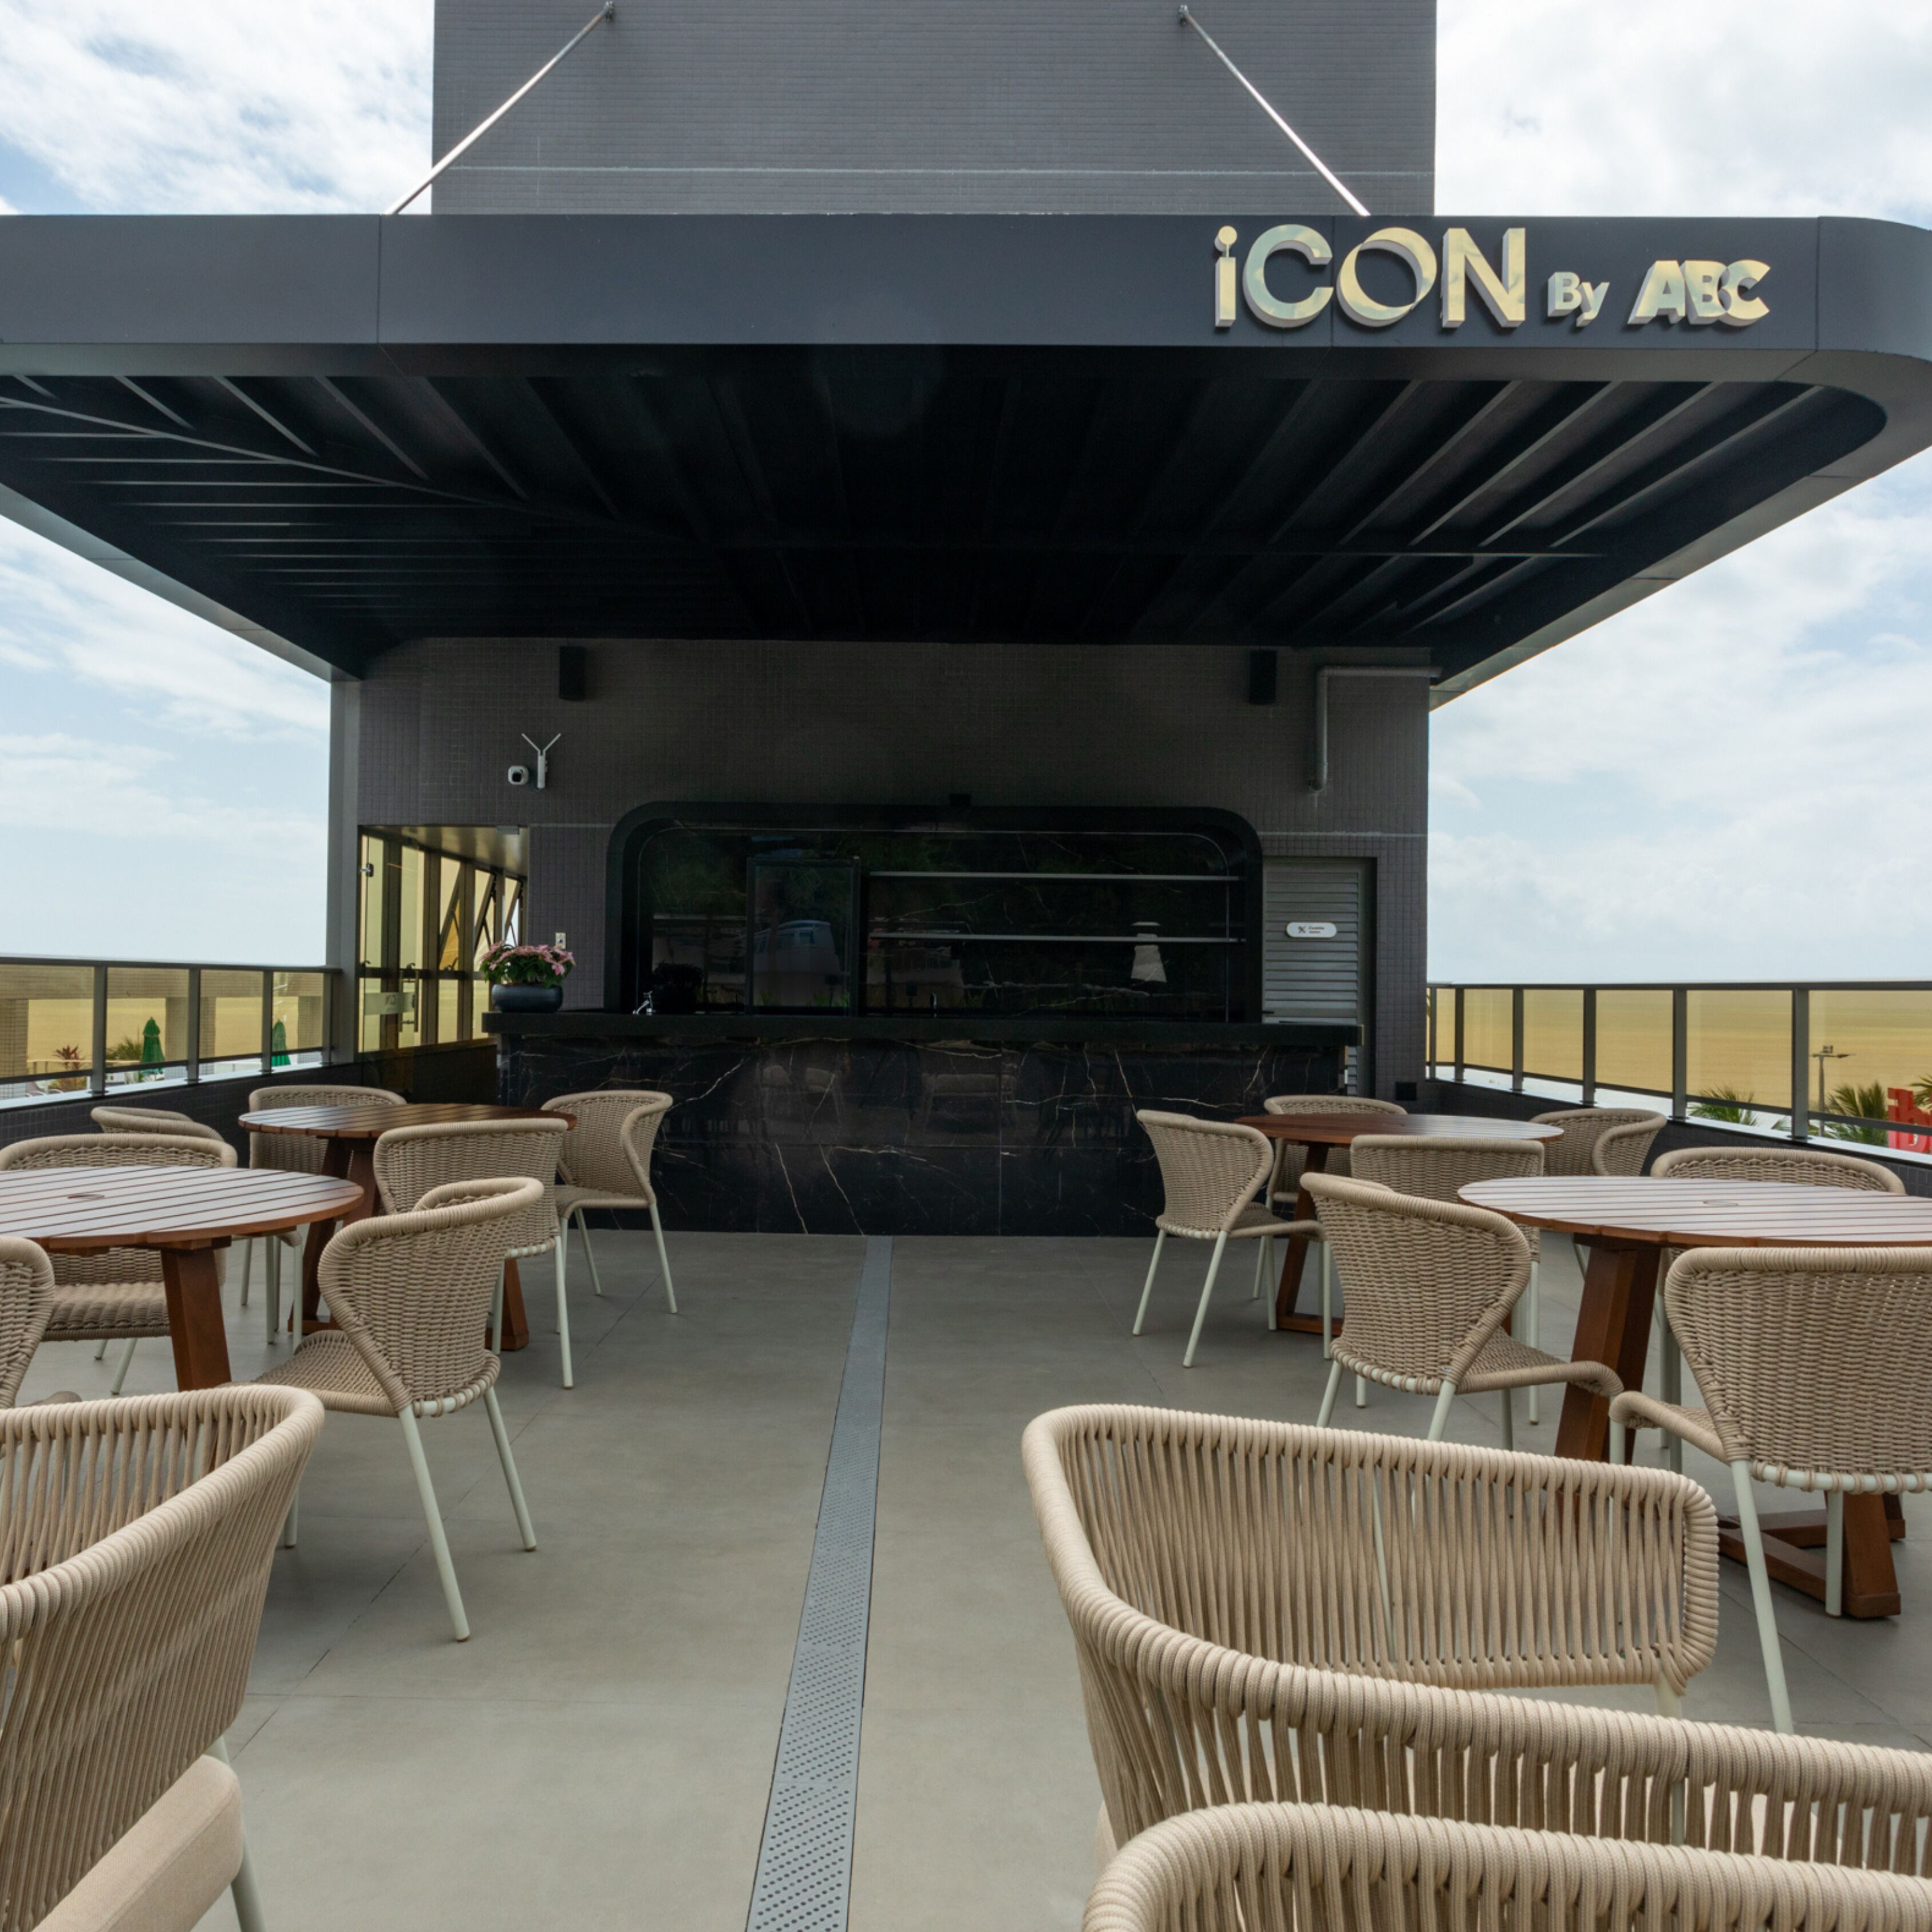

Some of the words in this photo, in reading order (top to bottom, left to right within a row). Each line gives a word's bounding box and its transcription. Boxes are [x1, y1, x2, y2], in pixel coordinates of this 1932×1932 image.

[1214, 224, 1526, 328] iCON
[1547, 272, 1610, 327] By
[1627, 259, 1771, 326] ABC
[1887, 1087, 1932, 1154] ib
